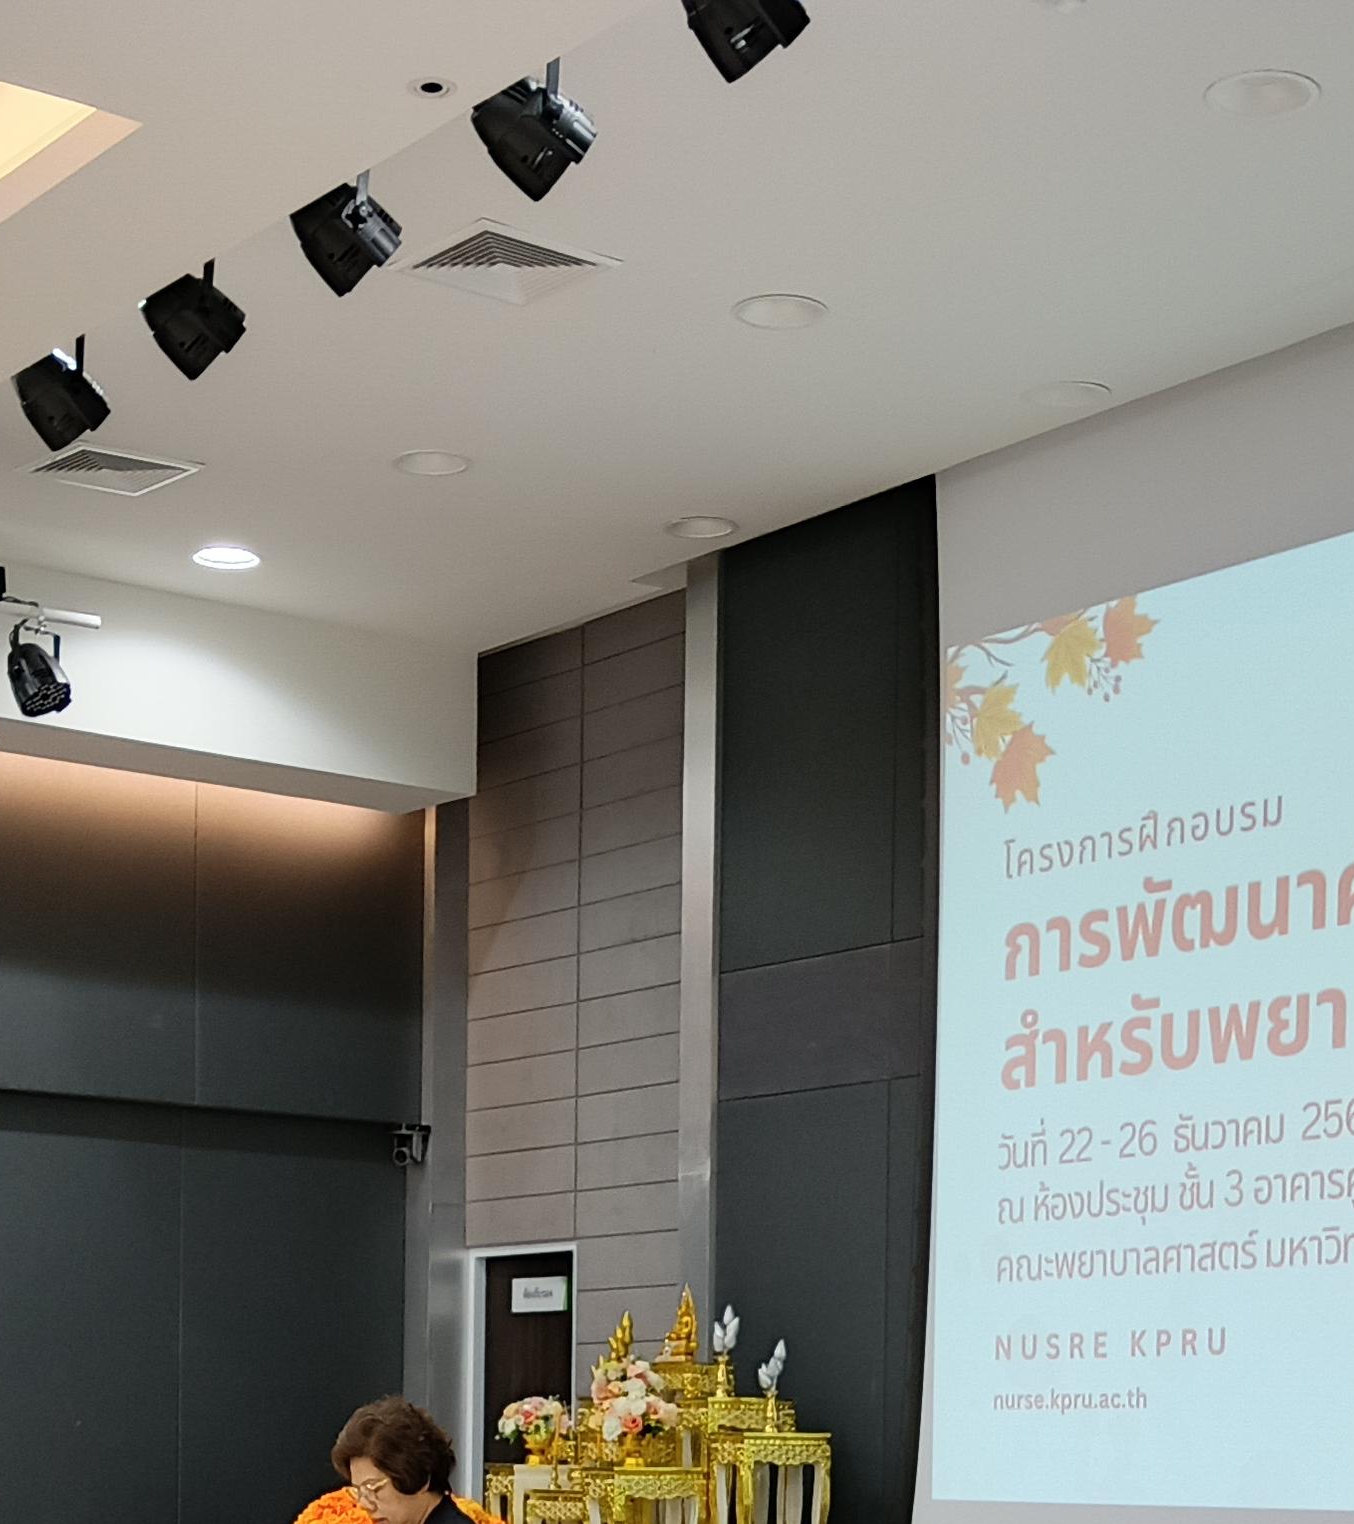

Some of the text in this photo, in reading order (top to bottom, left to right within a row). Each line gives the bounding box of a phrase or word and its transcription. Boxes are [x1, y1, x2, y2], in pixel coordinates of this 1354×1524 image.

[1004, 795, 1283, 879] โครงการฝึกอบรม
[997, 1118, 1047, 1171] วันที่
[1172, 1112, 1285, 1154] ธันวาคม
[997, 1196, 1024, 1225] ณ
[1033, 1180, 1169, 1226] ห้องประชุม
[1178, 1162, 1214, 1212] ชั้น
[1223, 1168, 1244, 1207] 3
[996, 1229, 1260, 1284] คณะพยาบาลศาสตร์
[994, 1326, 1227, 1361] NUSRE KPRU
[992, 1386, 1148, 1416] nurse.kpru.ac.th
